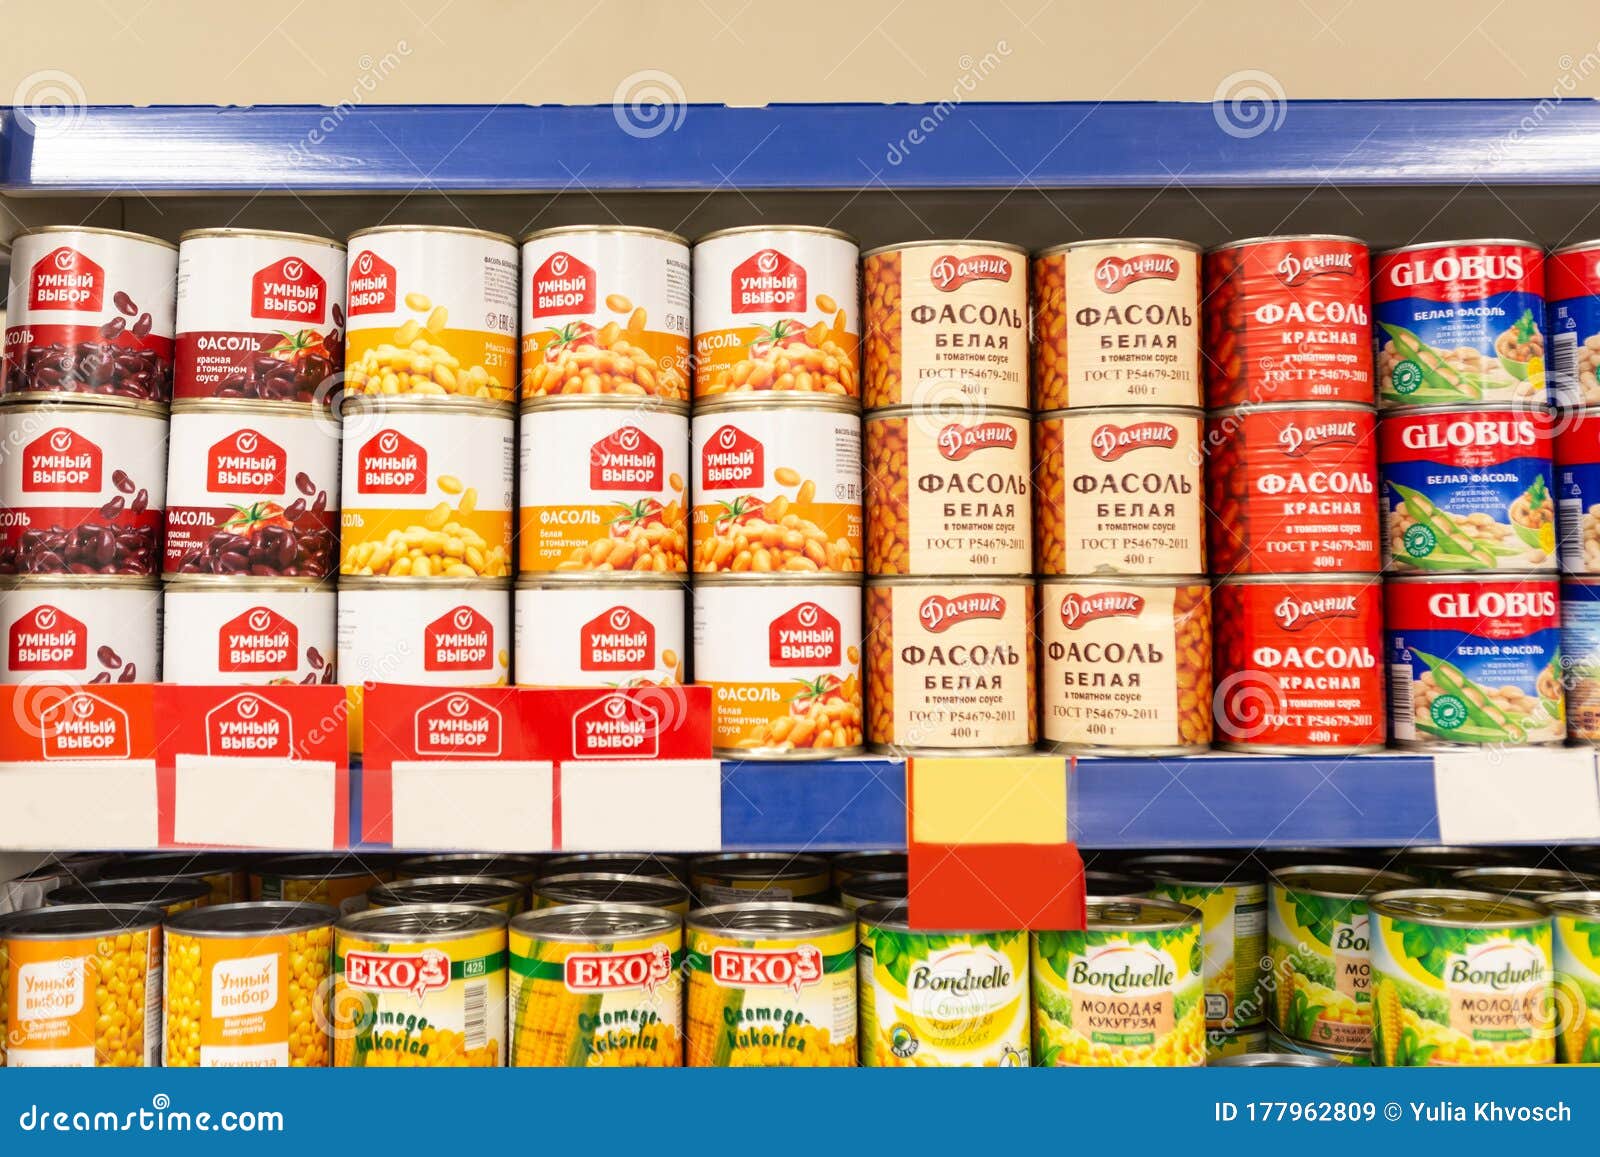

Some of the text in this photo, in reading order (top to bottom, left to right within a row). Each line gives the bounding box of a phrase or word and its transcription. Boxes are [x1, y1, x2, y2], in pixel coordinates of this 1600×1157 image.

[933, 256, 1008, 288] Дачник
[1097, 258, 1174, 288] Дачник
[1277, 253, 1353, 282] Дачник
[1390, 255, 1523, 287] GLOBUS
[38, 272, 94, 288] УМНЫЙ
[350, 274, 387, 292] УМНЫЙ
[537, 276, 585, 292] УМНЫЙ
[740, 275, 797, 289] УМНЫЙ
[38, 290, 90, 302] ВЫБОР
[263, 282, 319, 298] УМНЫЙ
[350, 292, 385, 307] ВЫБОР
[538, 294, 583, 308] ВЫБОР
[742, 291, 795, 304] ВЫБОР
[264, 299, 316, 314] ВЫБОР
[1255, 302, 1367, 325] ФАСОЛЬ
[911, 304, 1022, 329] ФАСОЛЬ
[1075, 304, 1192, 327] ФАСОЛЬ
[1414, 307, 1505, 321] БЕЛАЯ ФАСОЛЬ
[197, 335, 261, 351] ФАСОЛЬ
[935, 334, 1008, 349] БЕЛАЯ
[1100, 335, 1177, 349] БЕЛАЯ
[1282, 332, 1357, 344] КРАСНАЯ
[196, 356, 231, 365] красная
[943, 352, 1009, 364] томатном соусе
[1109, 353, 1178, 364] томатном соусе
[202, 365, 247, 373] томатном
[919, 368, 953, 379] ГОСТ
[1084, 369, 1121, 381] ГОСТ
[1264, 369, 1367, 381] ГОСТ 54679-2011
[196, 373, 219, 384] соусе
[960, 383, 981, 395] 400
[1127, 384, 1148, 395] 400
[1311, 384, 1330, 394] 400
[939, 426, 1014, 456] Дачник
[1094, 426, 1173, 456] Дачник
[1278, 422, 1356, 452] Дачник
[1402, 421, 1536, 449] GLOBUS
[32, 453, 91, 468] УМНЫЙ
[217, 454, 276, 470] УМНЫЙ
[364, 453, 416, 470] УМНЫЙ
[601, 451, 656, 467] УМНЫЙ
[707, 450, 754, 466] УМНЫЙ
[32, 471, 89, 484] ВЫБОР
[217, 472, 273, 485] ВЫБОР
[365, 473, 414, 485] ВЫБОР
[603, 470, 654, 483] ВЫБОР
[708, 468, 752, 481] ВЫБОР
[1427, 473, 1518, 485] БЕЛАЯ ФАСОЛЬ
[918, 473, 1027, 496] ФАСОЛЬ
[1073, 473, 1192, 494] ФАСОЛЬ
[1257, 472, 1372, 494] ФАСОЛЬ
[943, 503, 1015, 518] БЕЛАЯ
[1098, 504, 1175, 518] БЕЛАЯ
[1284, 503, 1361, 515] КРАСНАЯ
[168, 510, 215, 526] ФАСОЛЬ
[540, 510, 600, 525] ФАСОЛЬ
[540, 529, 563, 537] белая
[952, 522, 1015, 533] томатном соусе
[1105, 522, 1176, 533] томатном соусе
[546, 538, 588, 548] томатном
[927, 538, 963, 550] ГОСТ
[1081, 538, 1117, 550] ГОСТ
[1266, 540, 1372, 552] ГОСТ 54679-2011
[540, 548, 561, 557] соусе
[969, 554, 989, 565] 400
[1123, 553, 1144, 564] 400
[1313, 556, 1334, 567] 400
[1062, 595, 1139, 625] Дачник
[1274, 595, 1357, 627] Дачник
[1428, 592, 1555, 618] GLOBUS
[921, 596, 1000, 629] Дачник
[18, 630, 76, 646] УМНЫЙ
[229, 632, 289, 648] УМНЫЙ
[435, 631, 487, 647] УМНЫЙ
[592, 631, 647, 647] УМНЫЙ
[779, 627, 834, 643] УМНЫЙ
[18, 649, 73, 662] ВЫБОР
[230, 650, 287, 664] ВЫБОР
[437, 650, 486, 662] ВЫБОР
[592, 650, 644, 662] ВЫБОР
[781, 645, 832, 660] ВЫБОР
[901, 646, 1020, 666] ФАСОЛЬ
[1048, 643, 1164, 664] ФАСОЛЬ
[1253, 647, 1375, 668] ФАСОЛЬ
[1458, 645, 1544, 656] БЕЛАЯ ФАСОЛЬ
[925, 675, 1003, 689] БЕЛАЯ
[1065, 672, 1140, 687] БЕЛАЯ
[1279, 677, 1361, 689] КРАСНАЯ
[717, 688, 781, 701] ФАСОЛЬ
[933, 695, 1003, 705] томатном соусе
[1071, 692, 1142, 702] томатном соусе
[717, 706, 742, 715] белая
[909, 711, 945, 722] ГОСТ
[1052, 706, 1081, 718] ГОСТ
[55, 718, 115, 734] УМНЫЙ
[219, 718, 279, 735] УМНЫЙ
[428, 717, 489, 732] УМНЫЙ
[585, 718, 646, 734] УМНЫЙ
[724, 716, 768, 724] томатном
[1264, 714, 1302, 726] ГОСТ
[717, 725, 741, 735] соусе
[951, 726, 971, 738] 400
[1086, 724, 1108, 735] 400
[1307, 731, 1329, 742] 400
[57, 736, 114, 750] ВЫБОР
[221, 736, 278, 750] ВЫБОР
[430, 734, 487, 747] ВЫБОР
[587, 735, 644, 748] ВЫБОР
[350, 958, 415, 987] EKO
[466, 964, 483, 974] 425
[575, 956, 648, 987] EKO
[720, 955, 792, 983] EKO
[1451, 959, 1545, 990] Bonduelle
[25, 972, 75, 993] Умный
[220, 972, 270, 989] Умный
[913, 965, 1011, 997] Bonduelle
[1073, 961, 1174, 993] Bonduelle
[26, 993, 74, 1010] выбор
[221, 990, 269, 1006] выбор
[1081, 1000, 1162, 1016] МОЛОДАЯ
[1088, 1017, 1156, 1029] КУКУРУЗА
